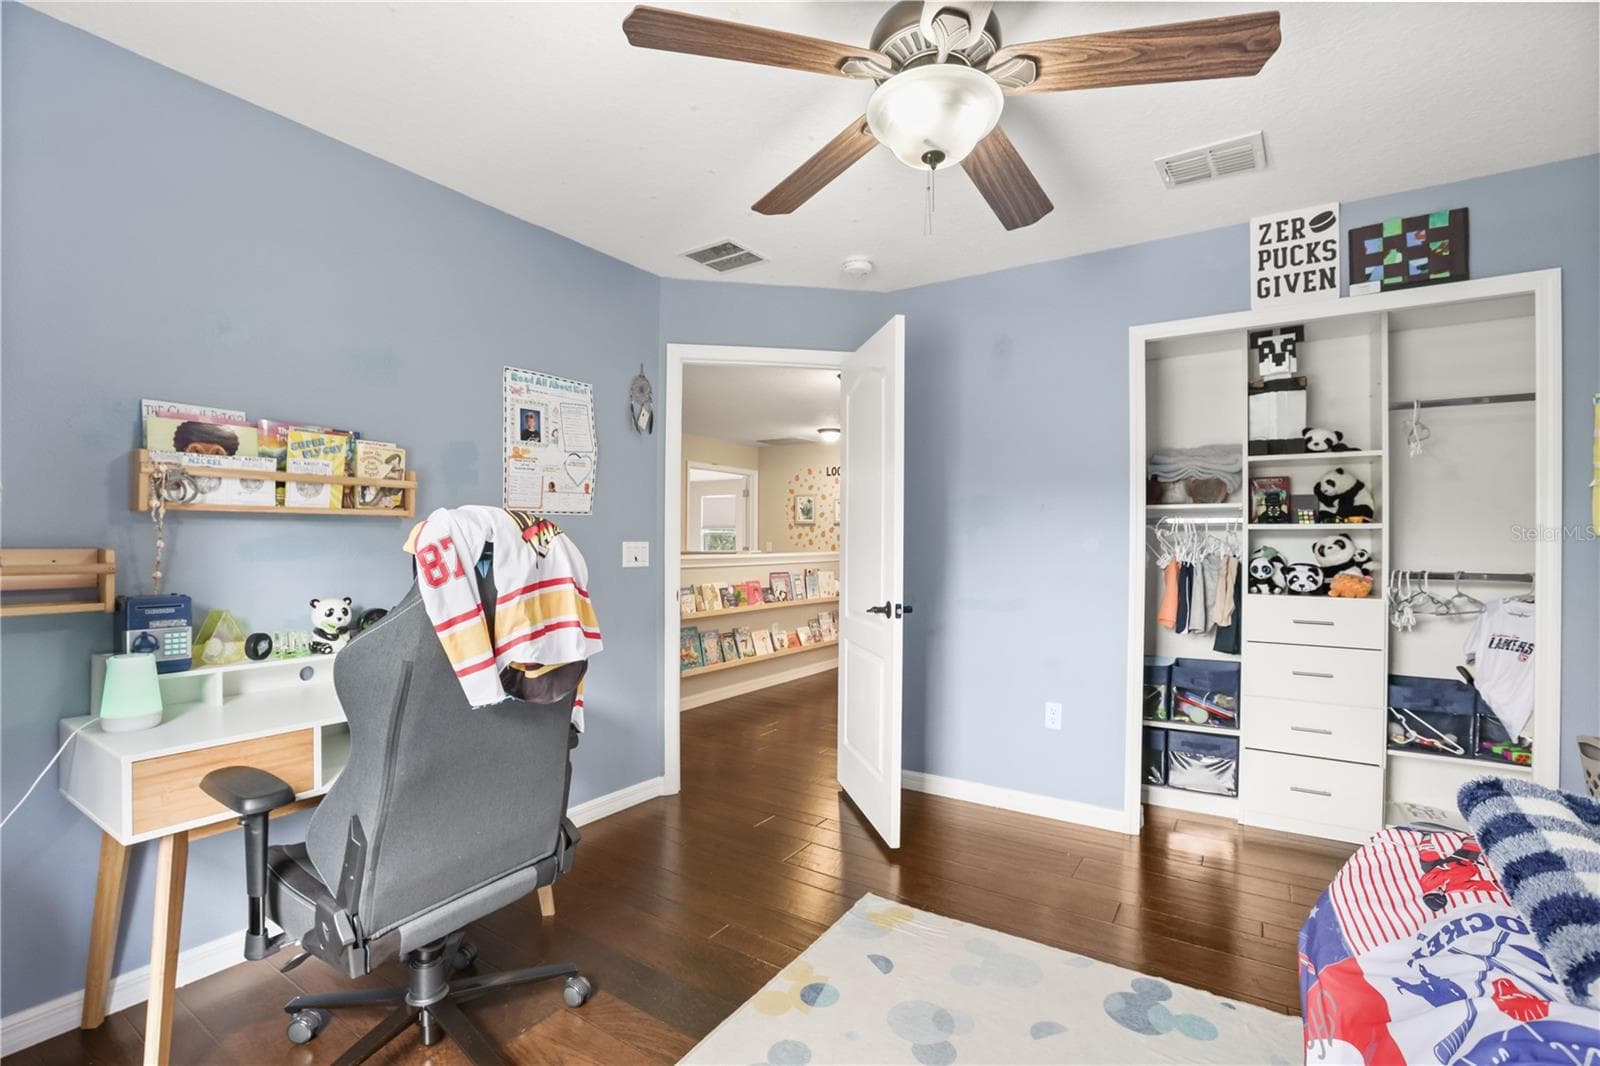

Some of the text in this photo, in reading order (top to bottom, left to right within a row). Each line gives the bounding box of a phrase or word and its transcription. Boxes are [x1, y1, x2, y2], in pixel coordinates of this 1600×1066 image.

[1259, 217, 1306, 246] ZER
[1258, 239, 1337, 272] PUCKS
[1256, 266, 1337, 299] GIVEN
[511, 372, 534, 384] Read
[536, 377, 548, 387] All
[549, 381, 573, 392] About
[290, 437, 325, 451] SUPER
[302, 444, 342, 459] FLY GUY
[187, 457, 222, 466] NICKEL
[417, 537, 466, 588] 87
[1488, 637, 1535, 655] LAKERS
[1407, 912, 1530, 968] OCKEY
